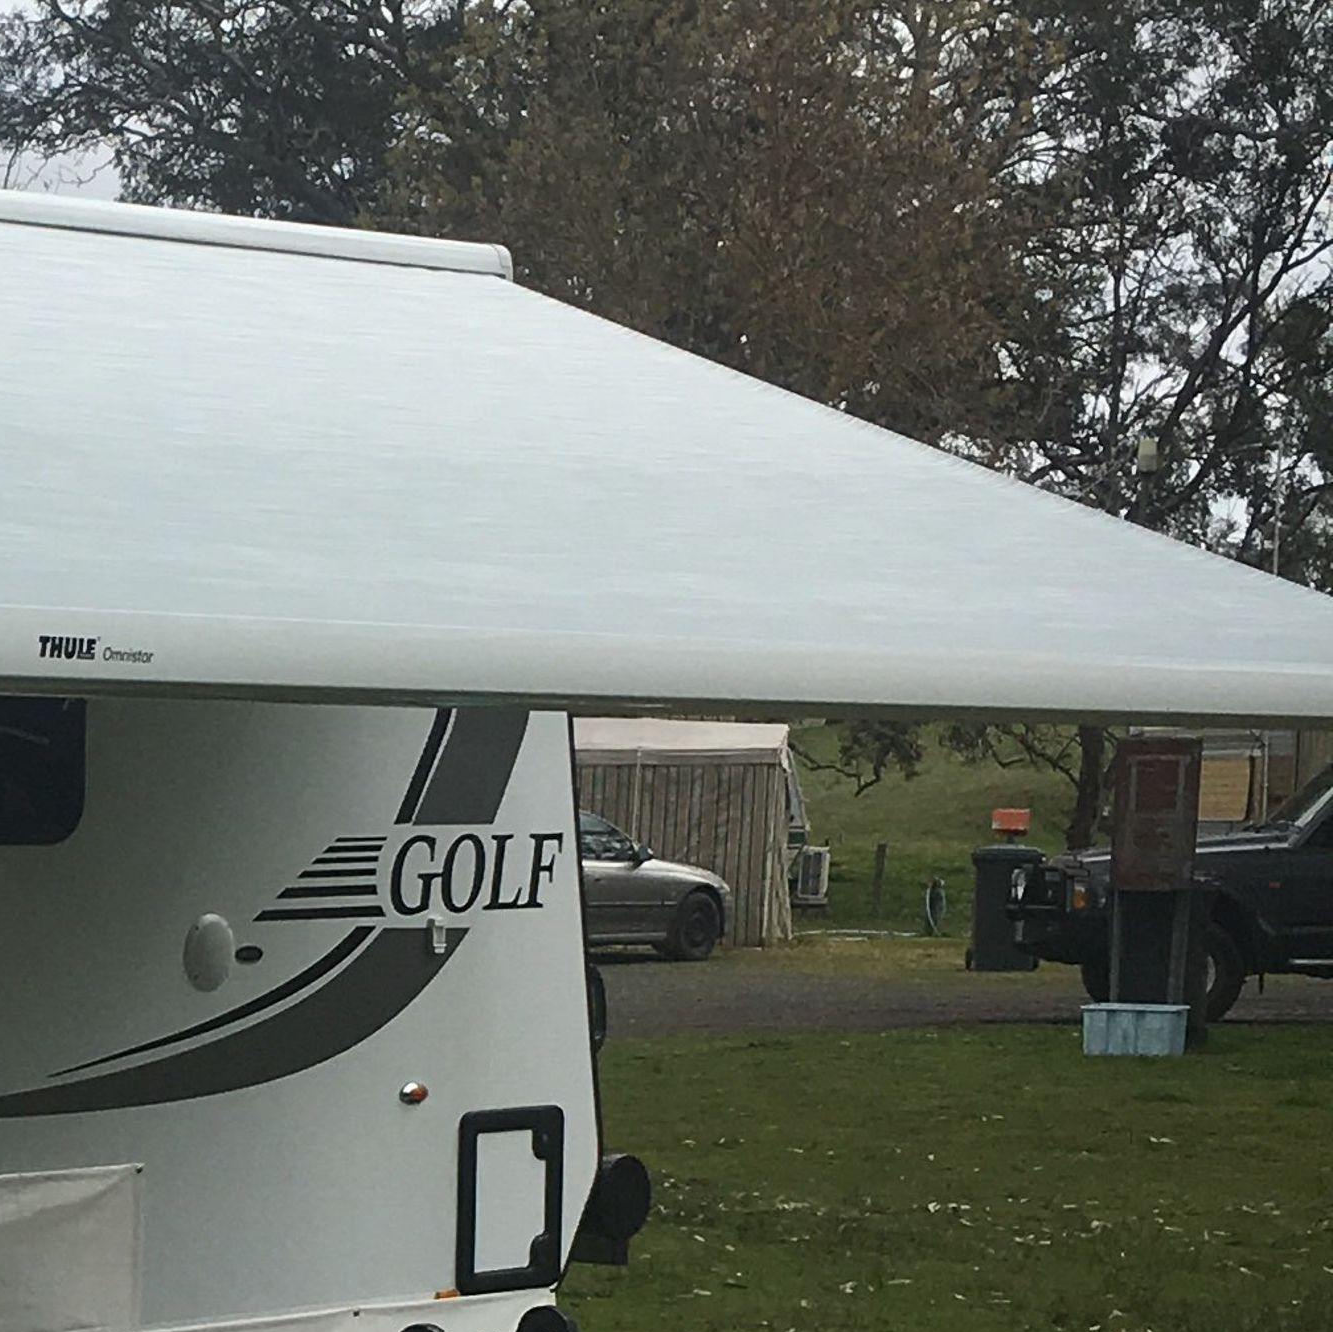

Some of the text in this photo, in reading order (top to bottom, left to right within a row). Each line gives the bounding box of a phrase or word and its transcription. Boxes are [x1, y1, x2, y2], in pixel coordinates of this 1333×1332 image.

[39, 636, 154, 663] THULE Omnistor
[390, 832, 564, 915] GOLF
